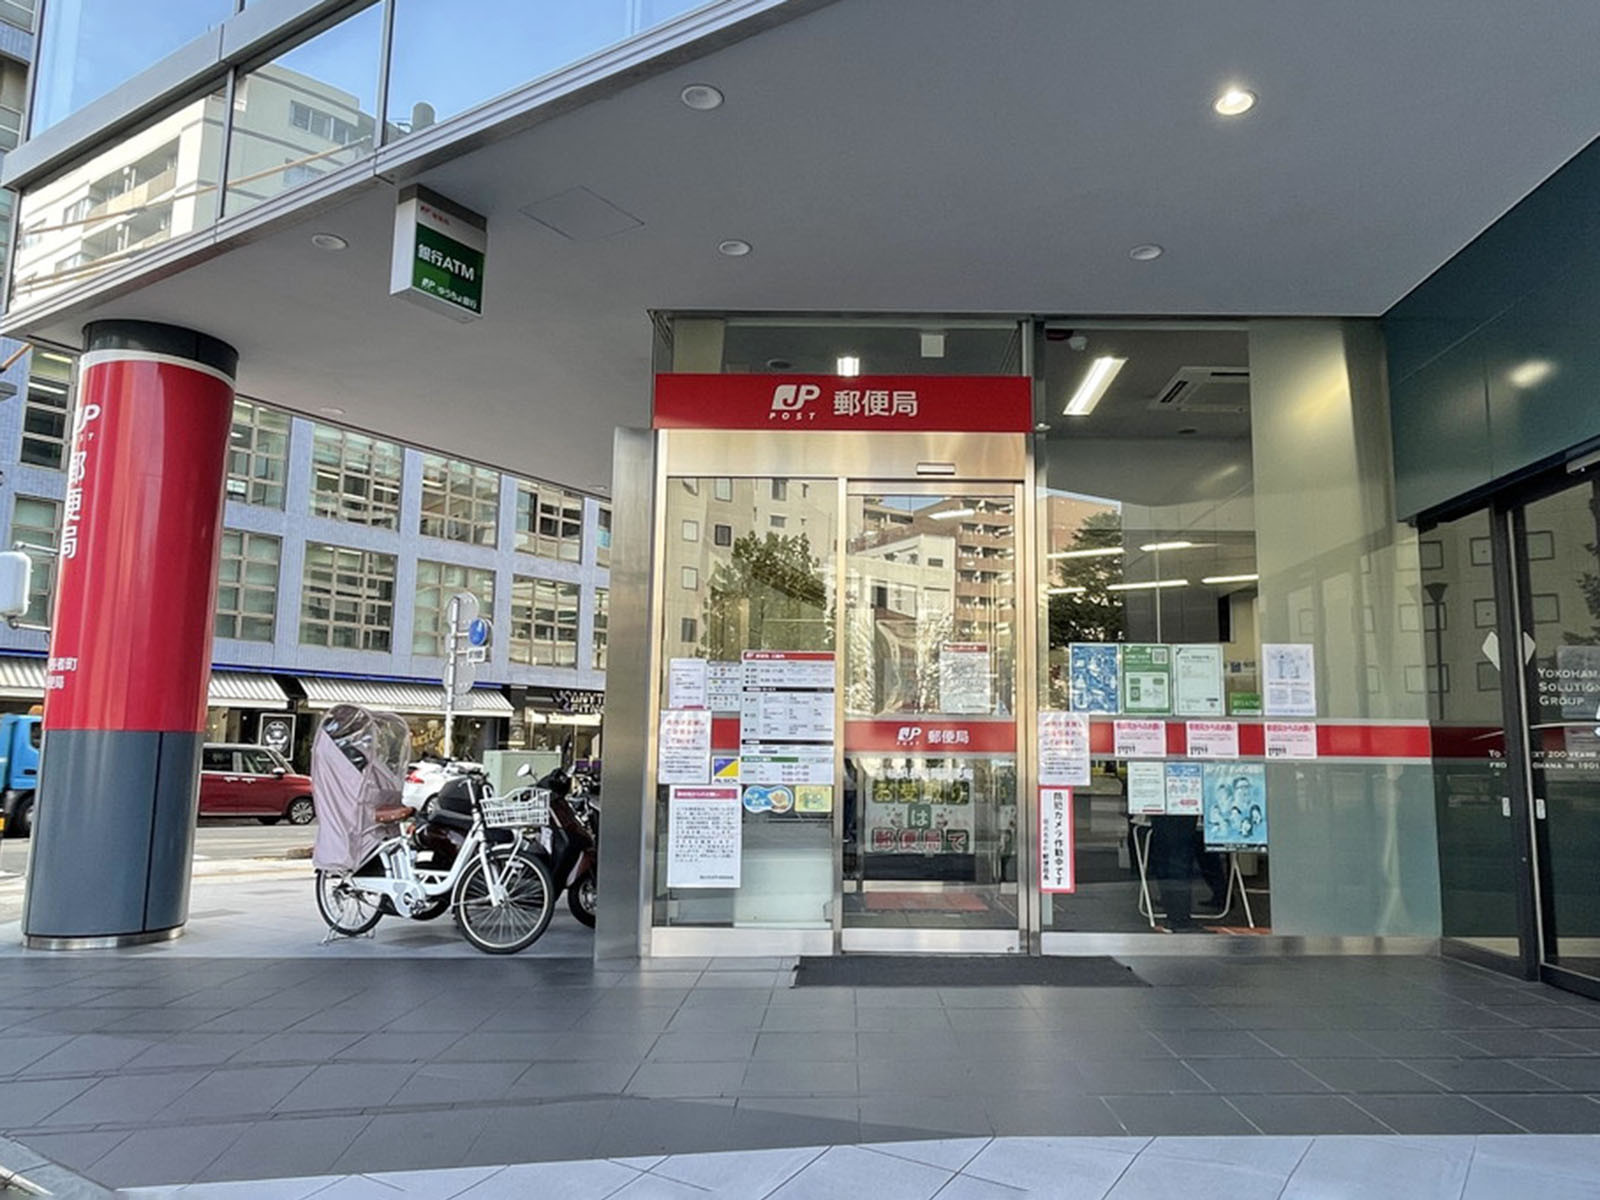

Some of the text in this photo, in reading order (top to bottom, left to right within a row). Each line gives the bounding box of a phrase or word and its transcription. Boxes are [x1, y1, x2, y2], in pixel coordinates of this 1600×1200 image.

[417, 243, 475, 282] 銀行ATM
[833, 389, 918, 417] 郵便局
[768, 412, 817, 421] POST
[1537, 667, 1600, 679] YOKOHAM
[1538, 695, 1585, 706] GROUP
[927, 729, 970, 745] 郵便局
[1548, 750, 1567, 758] 200
[910, 809, 930, 827] は
[874, 829, 967, 852] 郵便局で
[1053, 791, 1064, 886] 防犯カメラ作動中です
